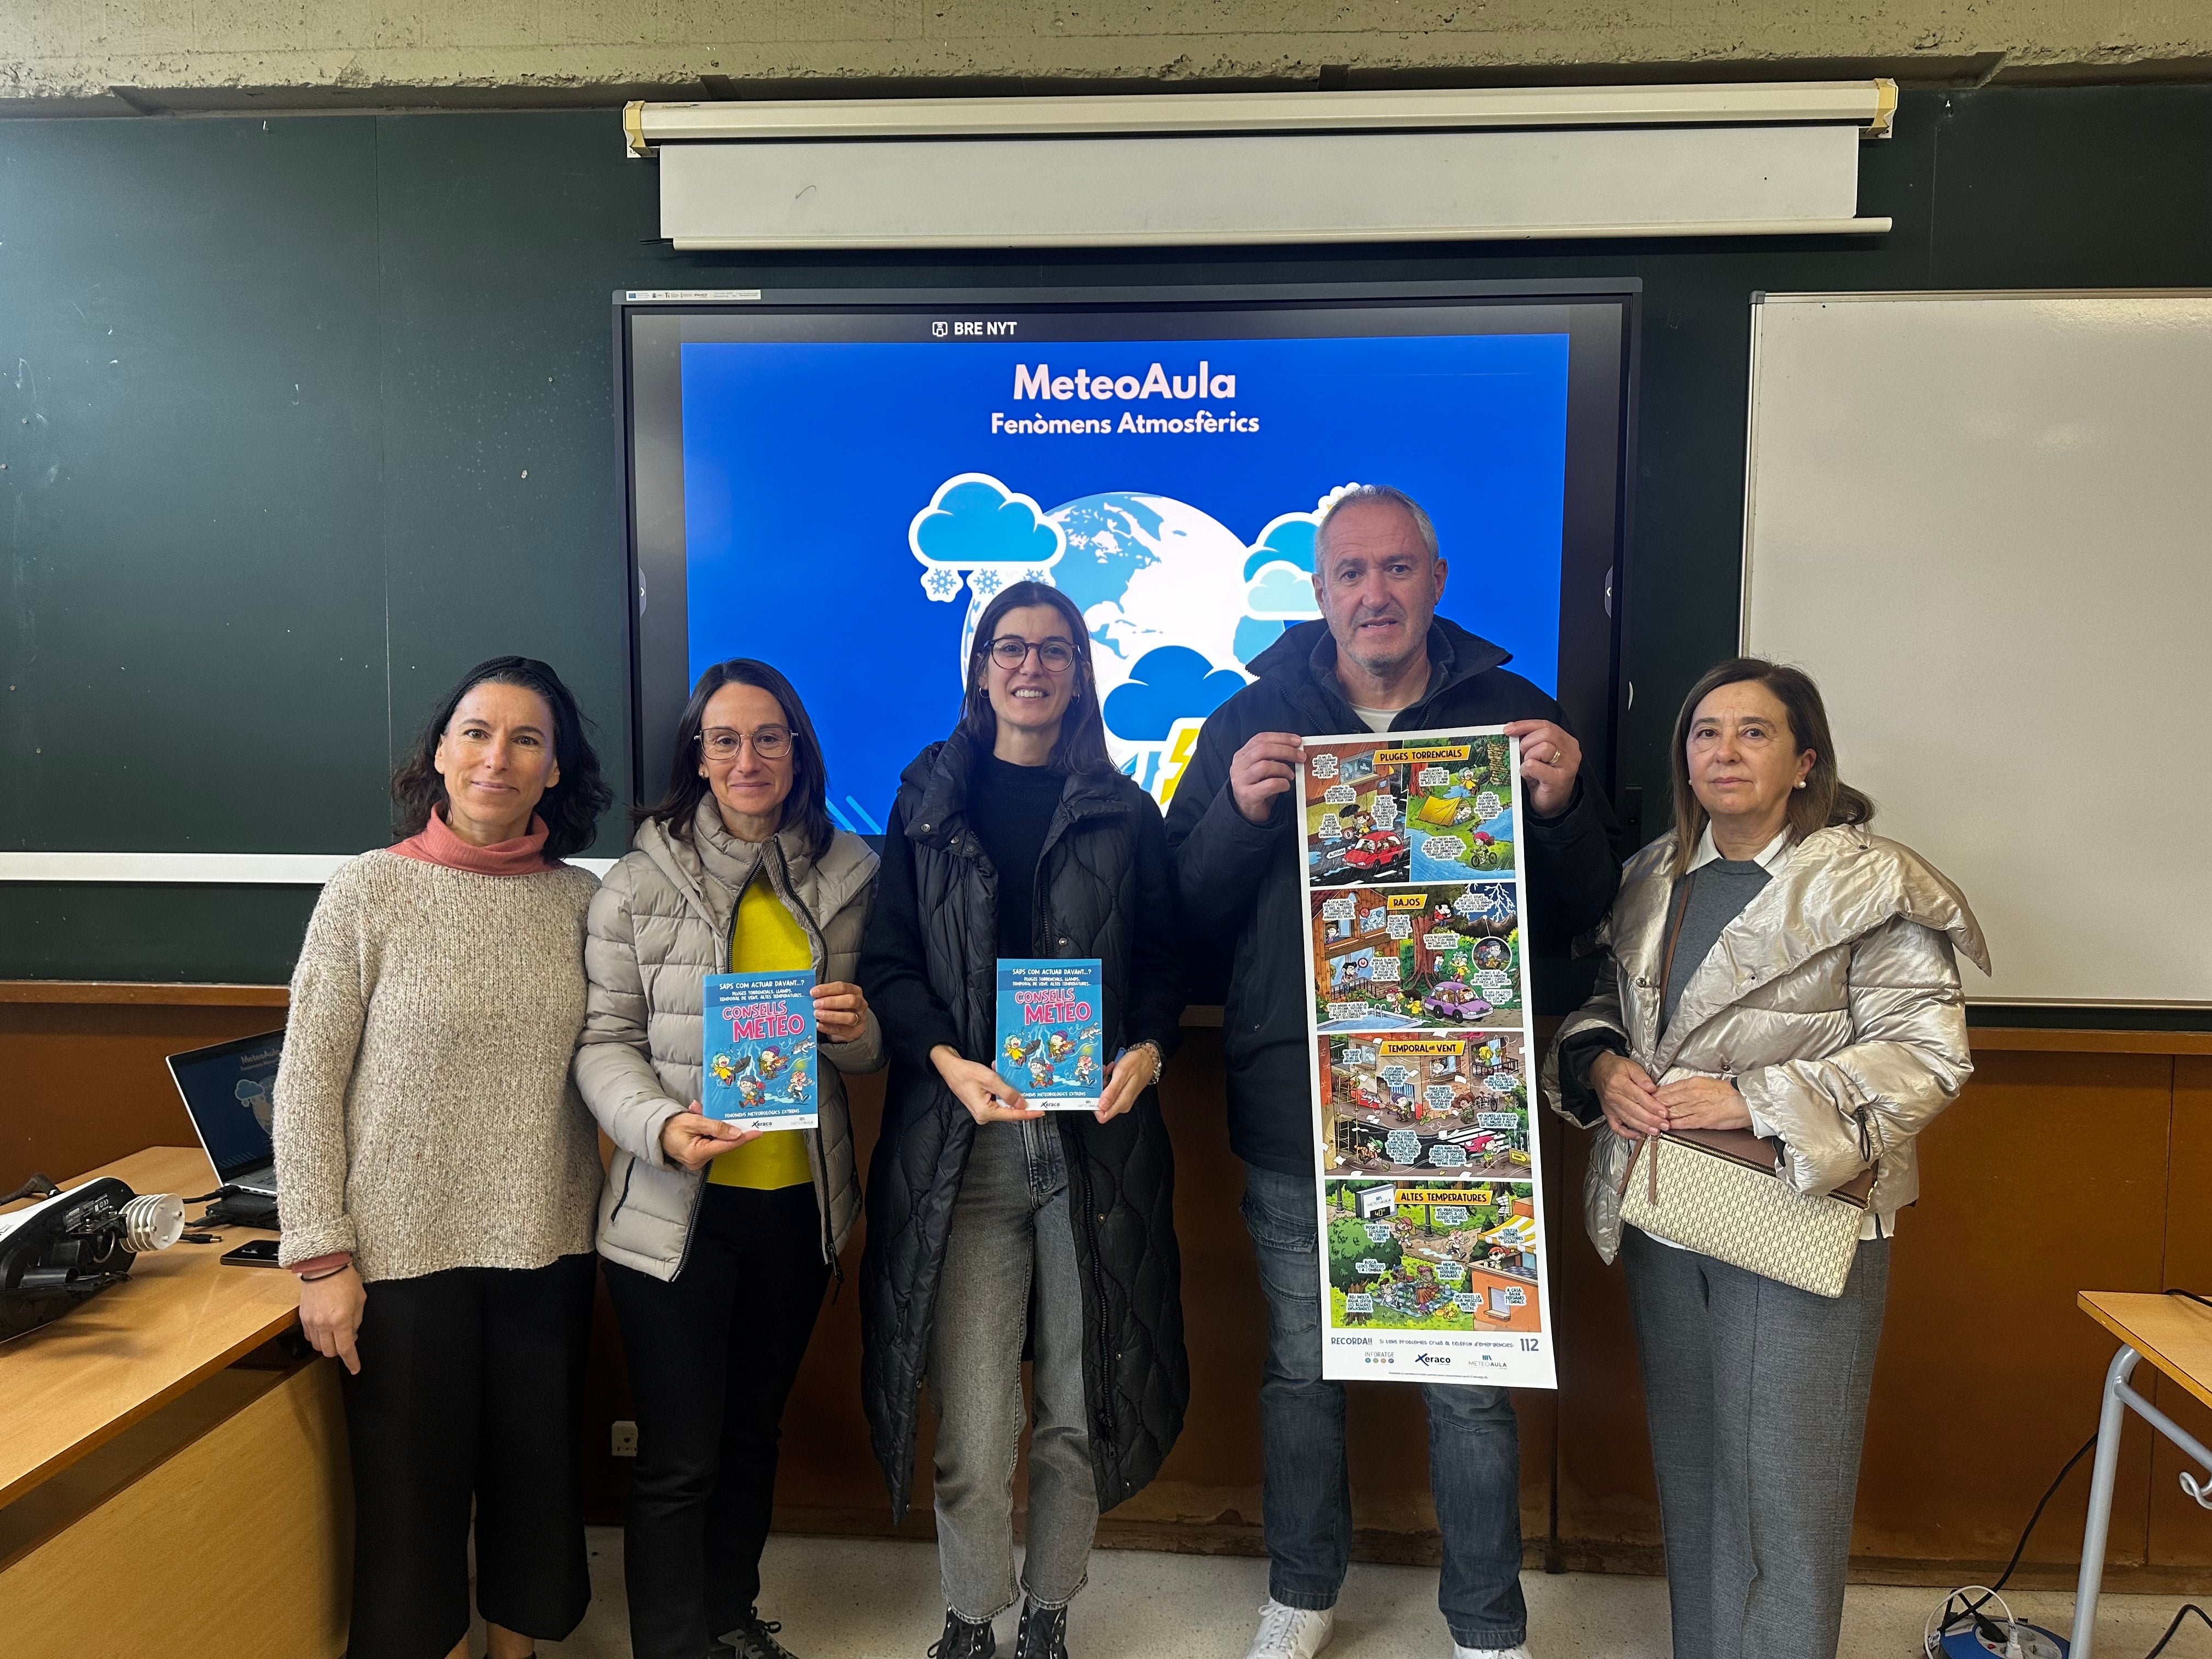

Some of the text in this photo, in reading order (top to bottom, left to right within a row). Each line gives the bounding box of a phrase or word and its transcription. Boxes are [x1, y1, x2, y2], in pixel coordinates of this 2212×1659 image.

[954, 321, 1017, 335] BRE NYT
[1013, 360, 1235, 400] MeteoAula
[991, 409, 1260, 435] Fenòmens Atmosfèrics
[1380, 749, 1462, 761] PLUGES TORRENCIALS
[1393, 898, 1420, 907] RAJOS
[1014, 988, 1075, 1004] CONSELLS
[722, 1000, 788, 1020] CONSELLS
[1024, 1001, 1092, 1026] METEO
[732, 1014, 805, 1042] METEO
[1388, 1044, 1429, 1053] TEMPORAL
[1437, 1044, 1457, 1052] VENT
[751, 1120, 772, 1128] Xeraco
[1367, 1199, 1391, 1207] METEOAULA
[1401, 1192, 1487, 1203] ALTES TEMPERATURES
[1520, 1338, 1539, 1351] 112
[1415, 1353, 1451, 1367] Xeraco
